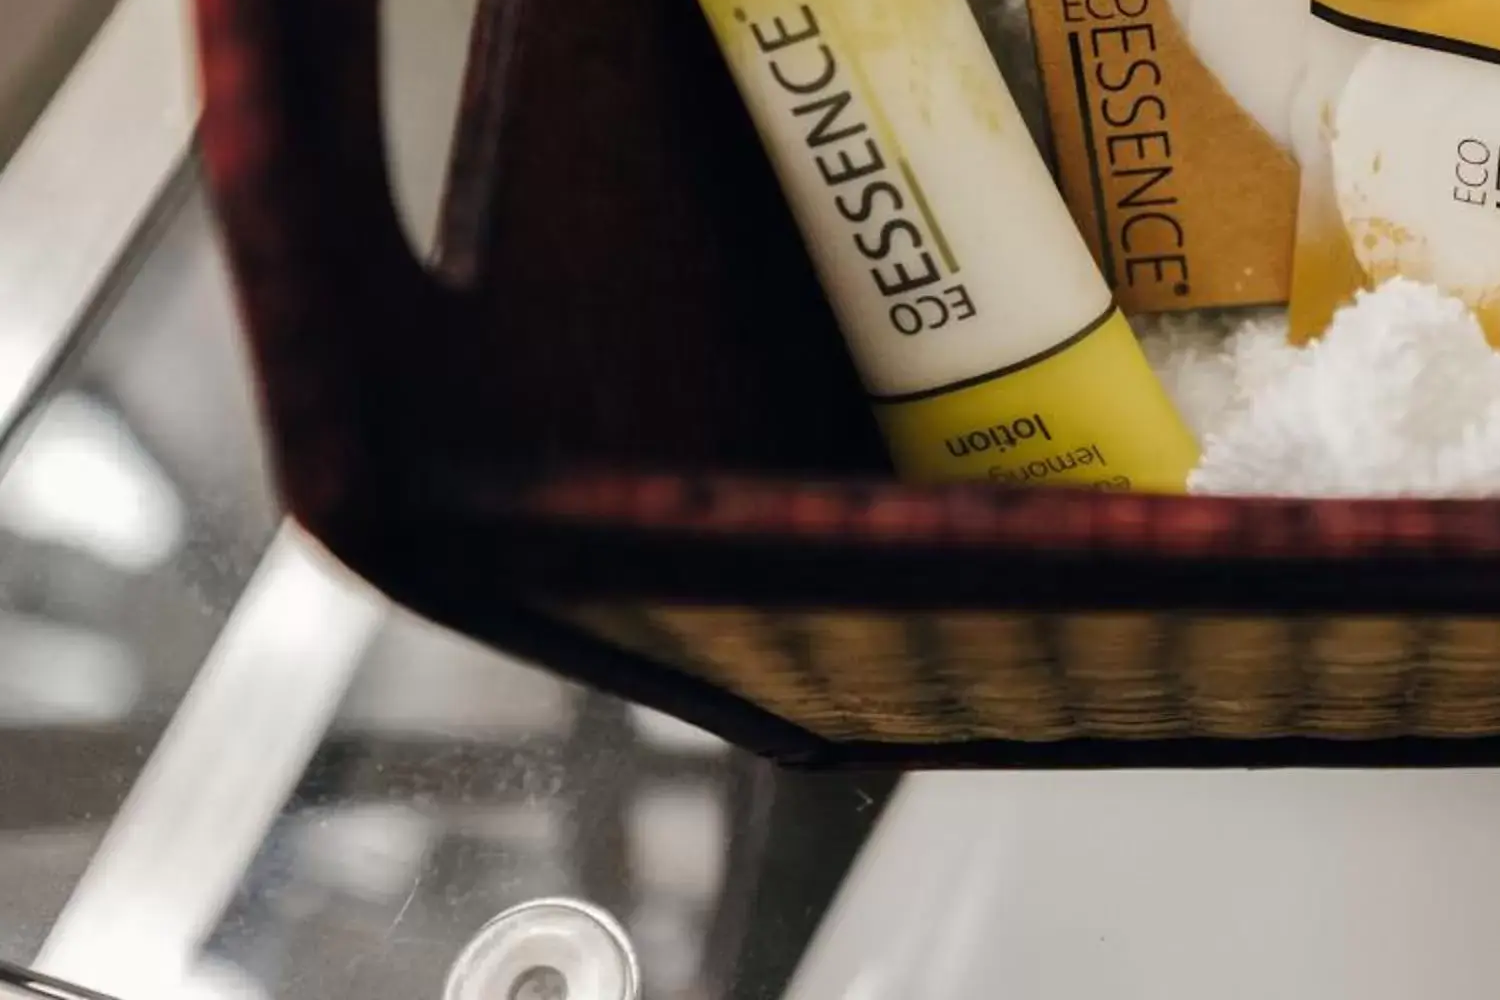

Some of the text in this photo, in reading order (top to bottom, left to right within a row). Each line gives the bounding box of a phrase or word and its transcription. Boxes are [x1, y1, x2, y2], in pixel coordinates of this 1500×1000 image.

[750, 3, 942, 298] ESSENCE
[1091, 25, 1187, 286] ESSENCE
[1453, 137, 1492, 207] ECO
[888, 284, 977, 336] ECO
[945, 414, 1052, 459] lotion
